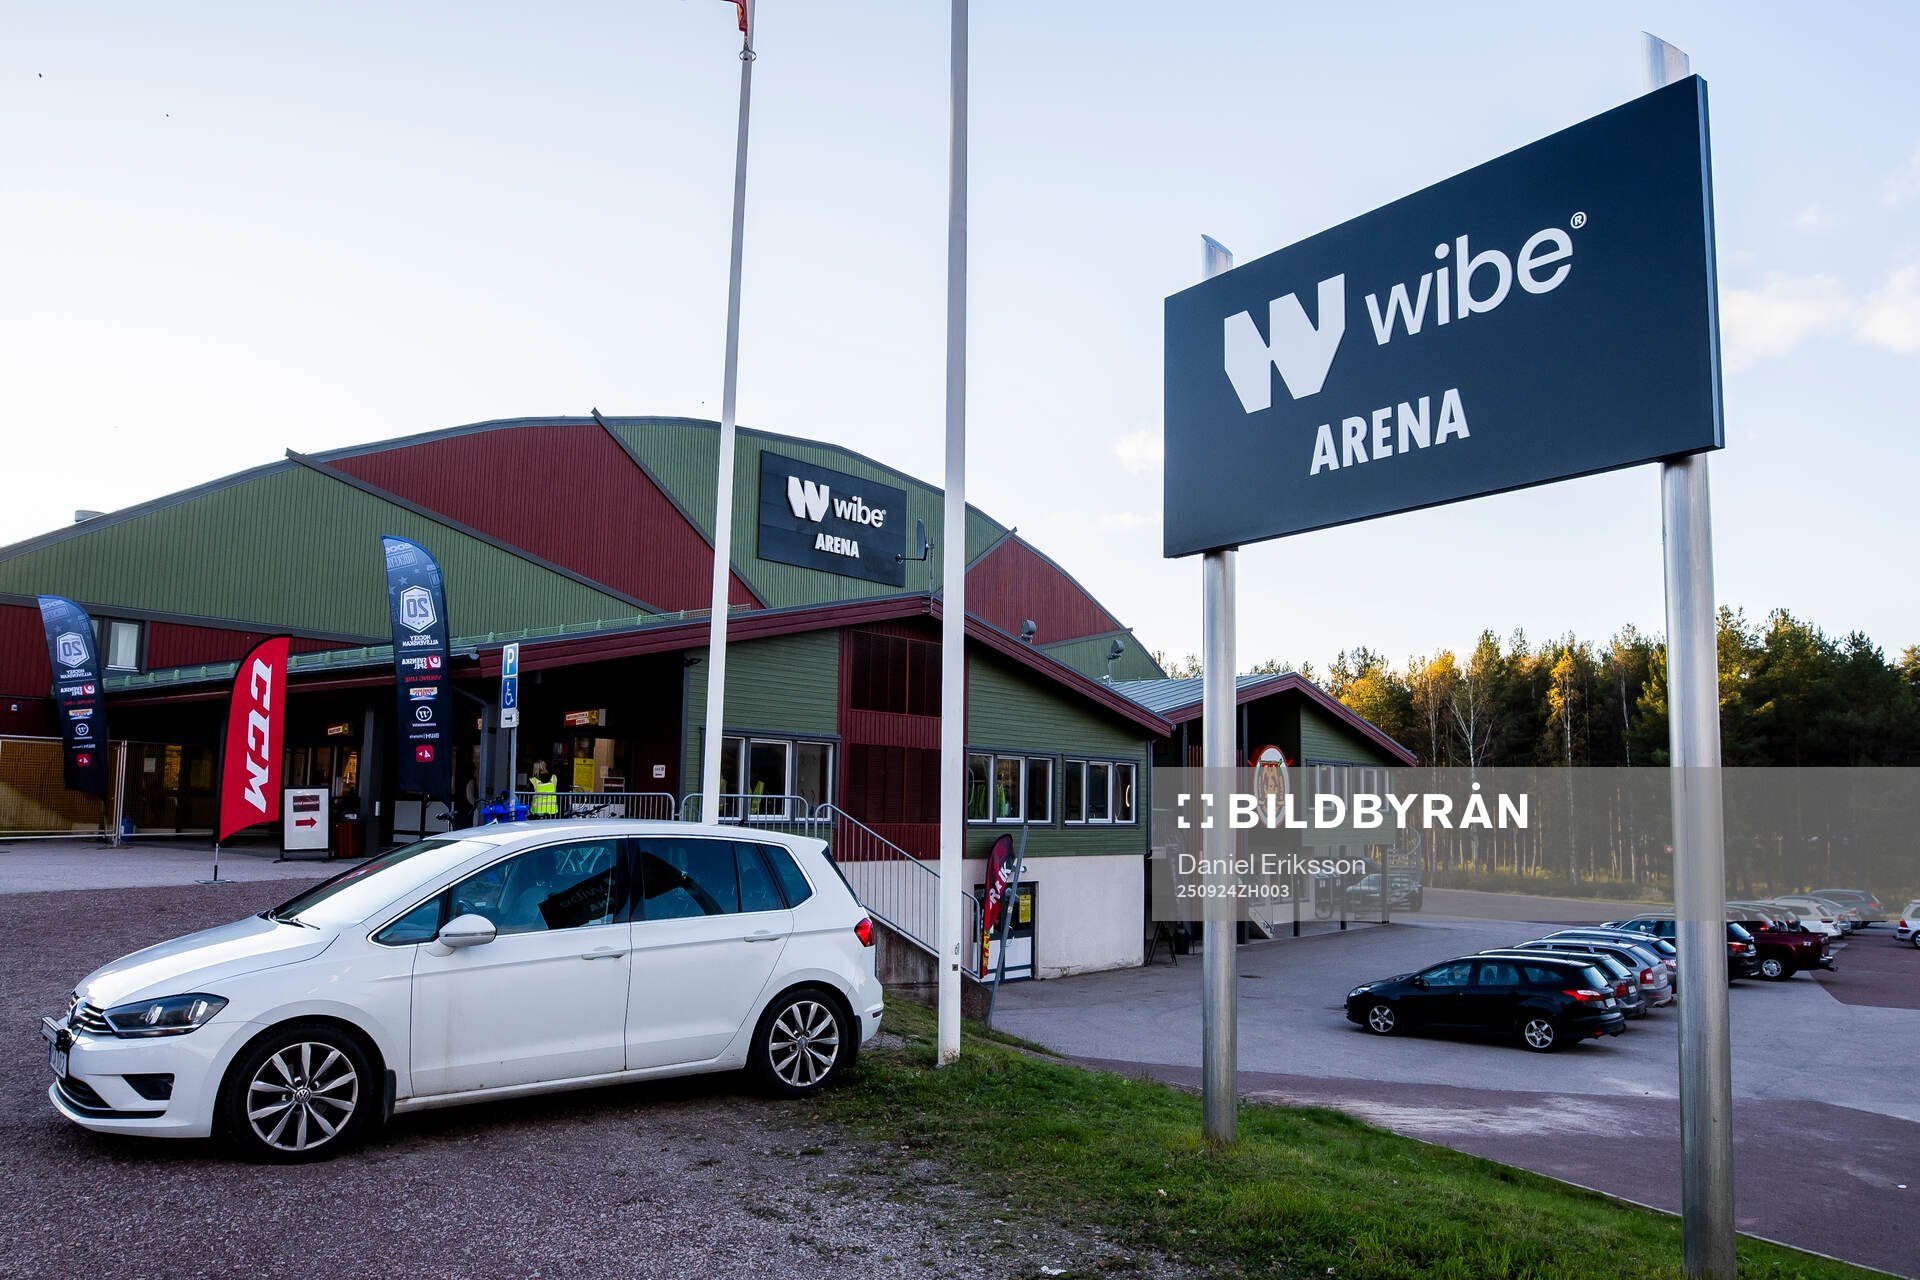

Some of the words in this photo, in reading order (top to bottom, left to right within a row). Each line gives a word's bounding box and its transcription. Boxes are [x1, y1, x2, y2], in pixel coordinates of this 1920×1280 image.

[1309, 387, 1471, 476] ARENA
[814, 533, 860, 559] ARENA
[244, 658, 272, 814] CCM
